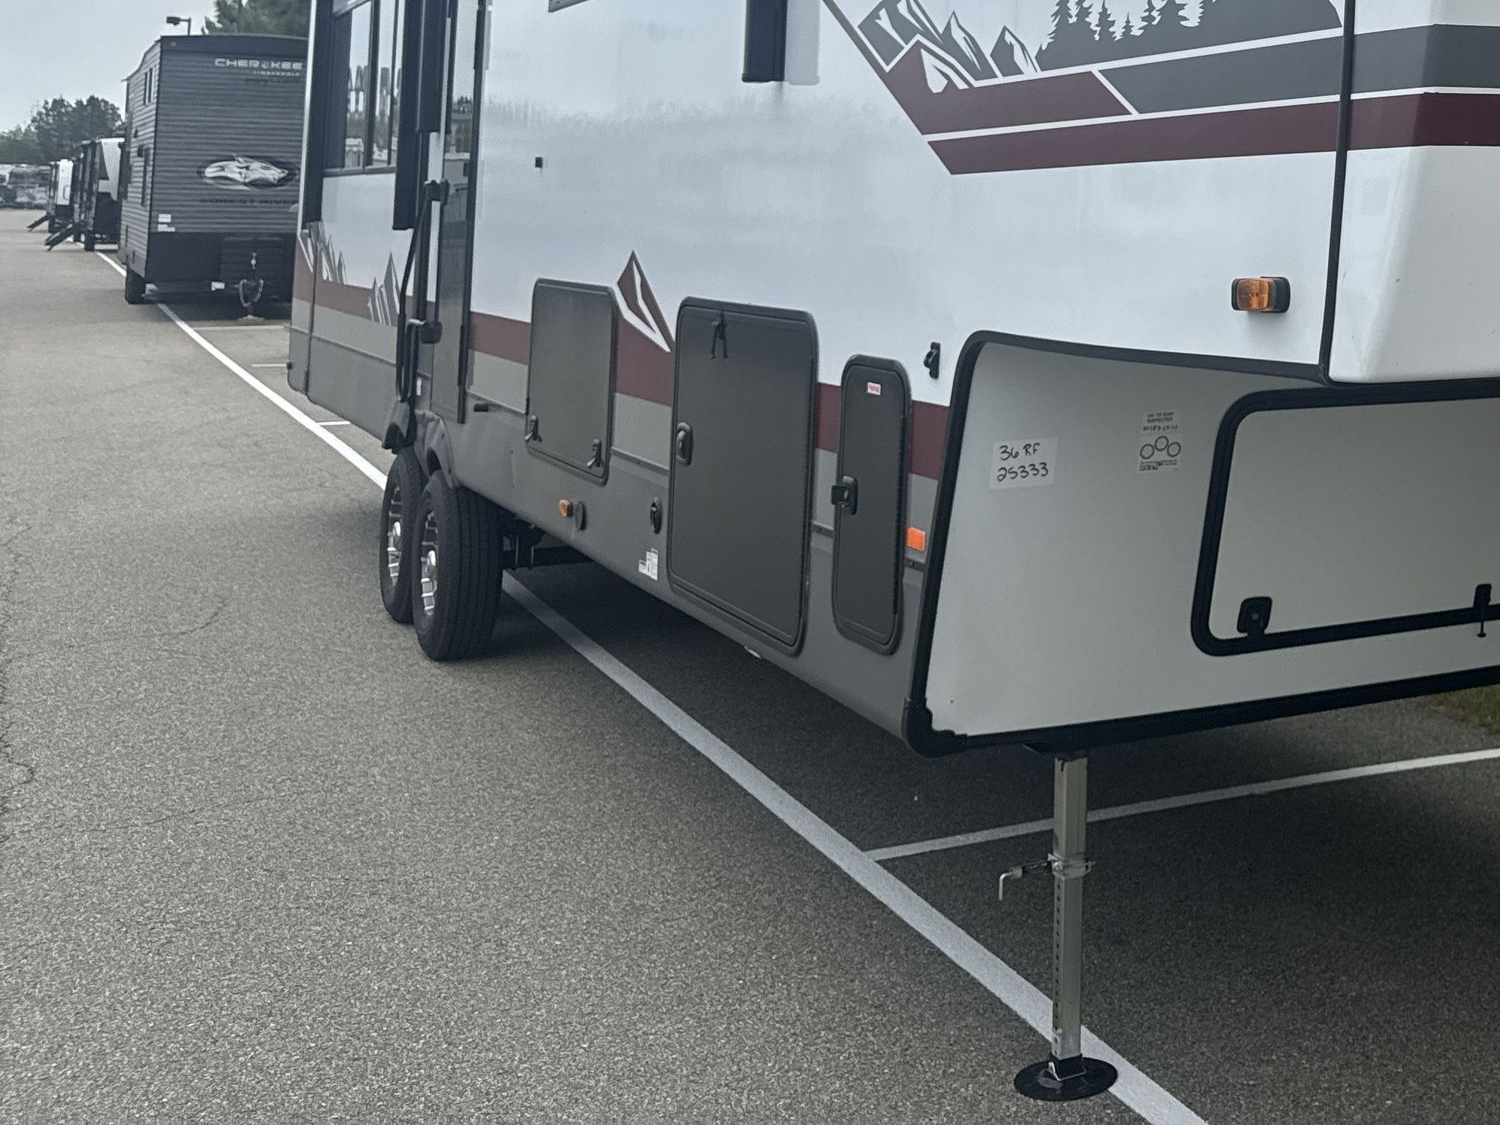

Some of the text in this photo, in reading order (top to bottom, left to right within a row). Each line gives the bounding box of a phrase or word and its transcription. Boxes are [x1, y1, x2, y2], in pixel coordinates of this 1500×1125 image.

[214, 58, 303, 70] CHEROKEE
[999, 442, 1041, 461] 36 RF
[997, 462, 1049, 482] 25333
